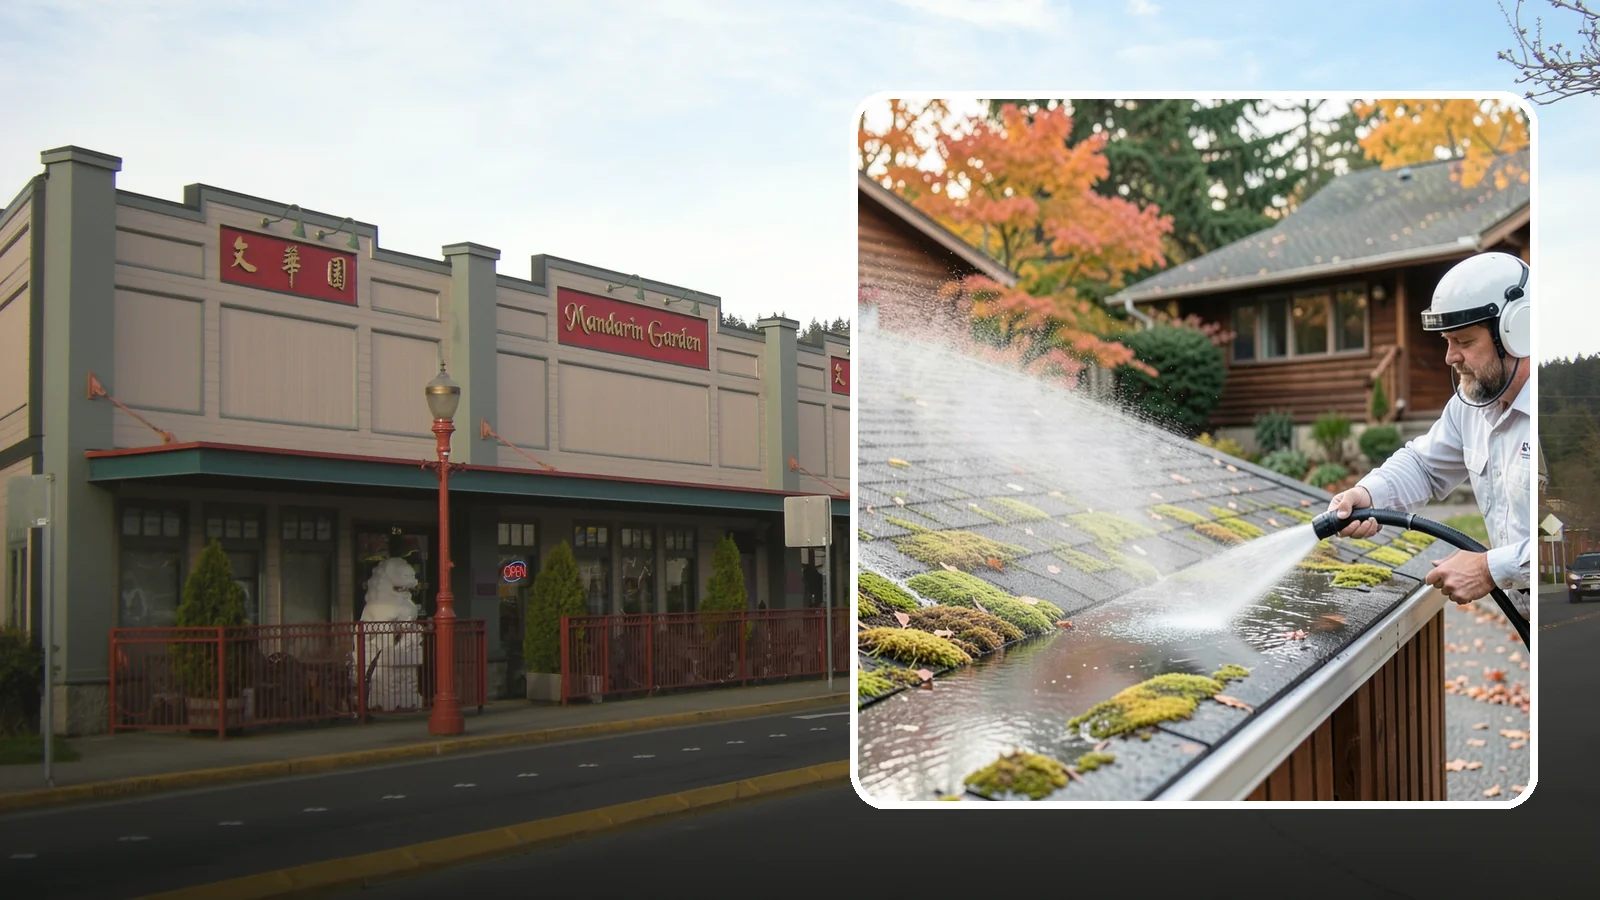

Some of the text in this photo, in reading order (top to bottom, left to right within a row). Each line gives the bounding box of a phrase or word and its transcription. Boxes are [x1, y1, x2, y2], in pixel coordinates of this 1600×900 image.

[231, 235, 346, 290] 文華園
[564, 302, 701, 352] Mandarin Garden
[835, 363, 846, 386] 文
[503, 565, 527, 578] OPEN
